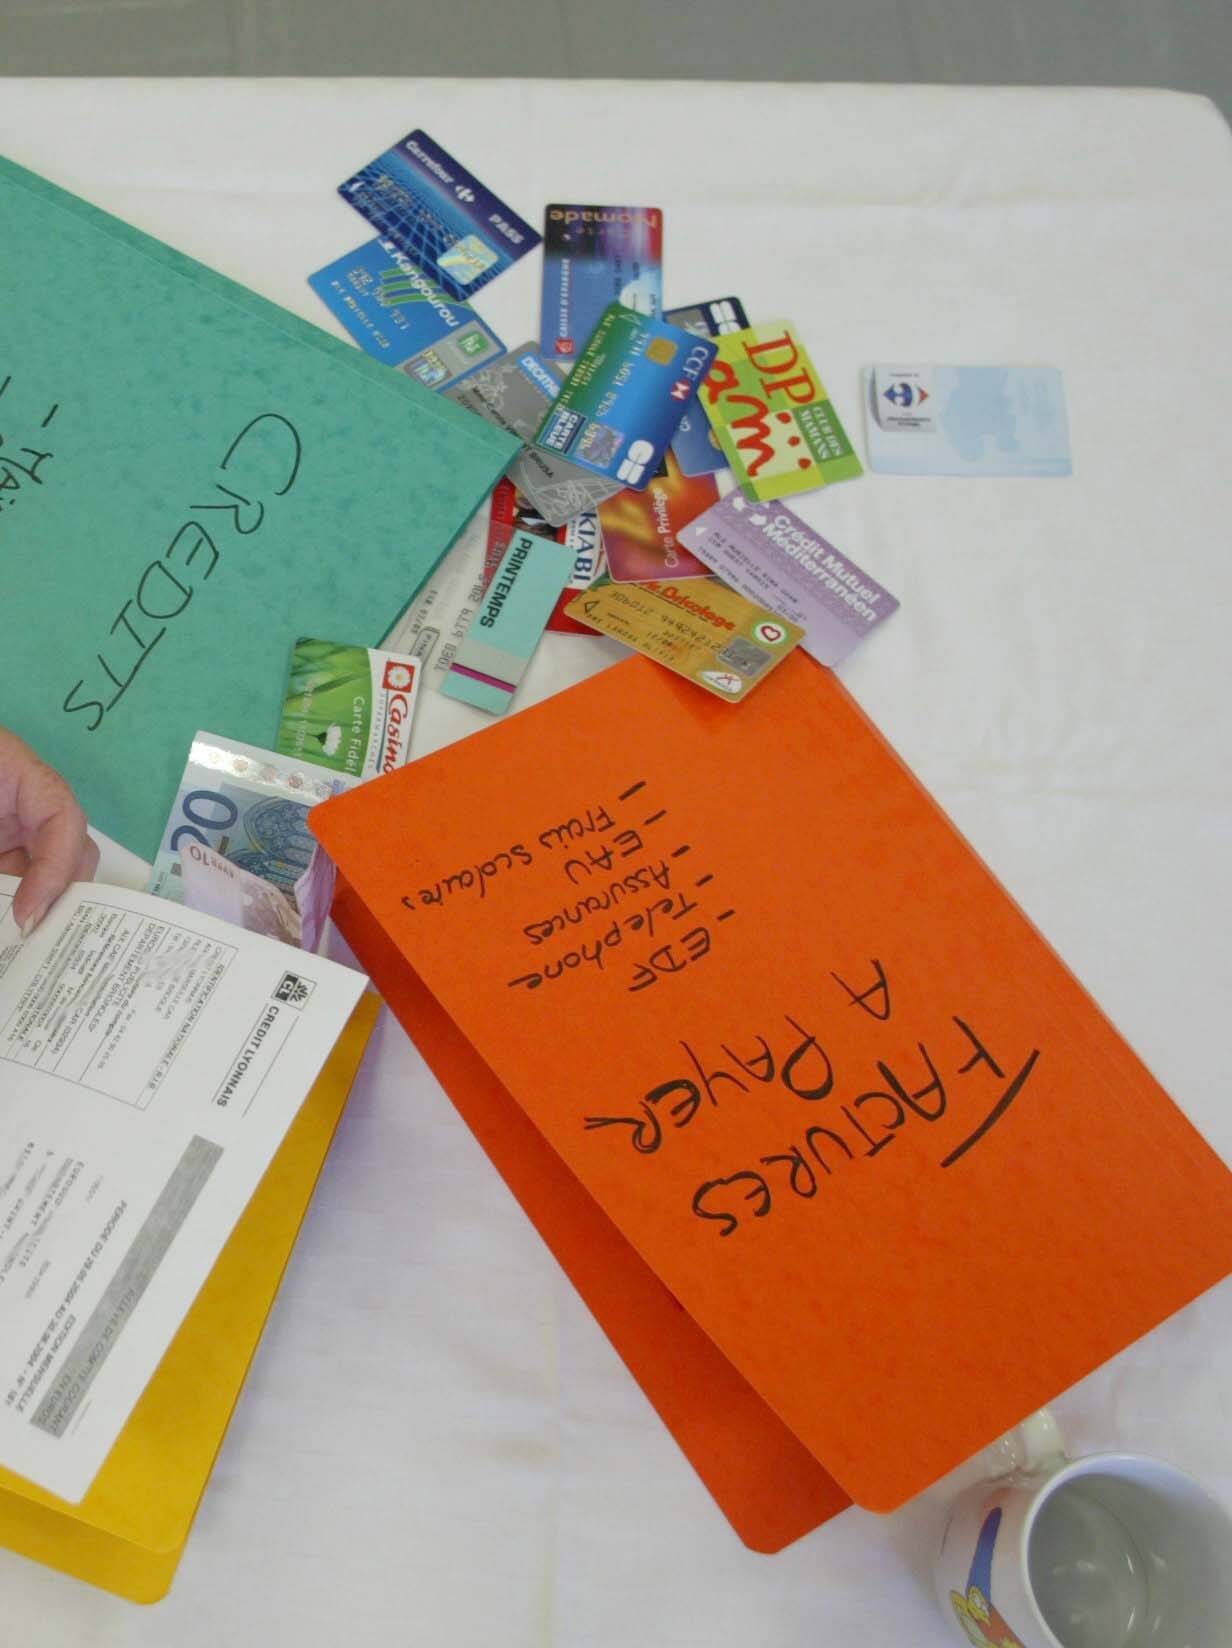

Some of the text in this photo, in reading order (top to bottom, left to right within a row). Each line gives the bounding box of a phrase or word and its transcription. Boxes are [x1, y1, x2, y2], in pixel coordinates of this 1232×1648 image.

[405, 140, 455, 184] Carrefour
[488, 213, 525, 244] PASS
[683, 346, 708, 380] CCF
[547, 411, 569, 446] BLEUE
[558, 415, 577, 449] CARTE
[63, 412, 302, 731] CREDITS
[572, 511, 598, 582] KIABI
[822, 554, 881, 604] Mutuel
[479, 537, 534, 628] PRINTEMPS
[351, 695, 366, 733] Carte
[382, 692, 409, 772] Casino
[189, 845, 210, 866] 10
[563, 829, 644, 884] EAU
[628, 926, 711, 992] EDF
[829, 959, 890, 1020] A
[215, 1004, 279, 1108] CREDIT LYONNAIS
[584, 1015, 834, 1154] PAYER
[692, 1015, 1040, 1237] FACTURES
